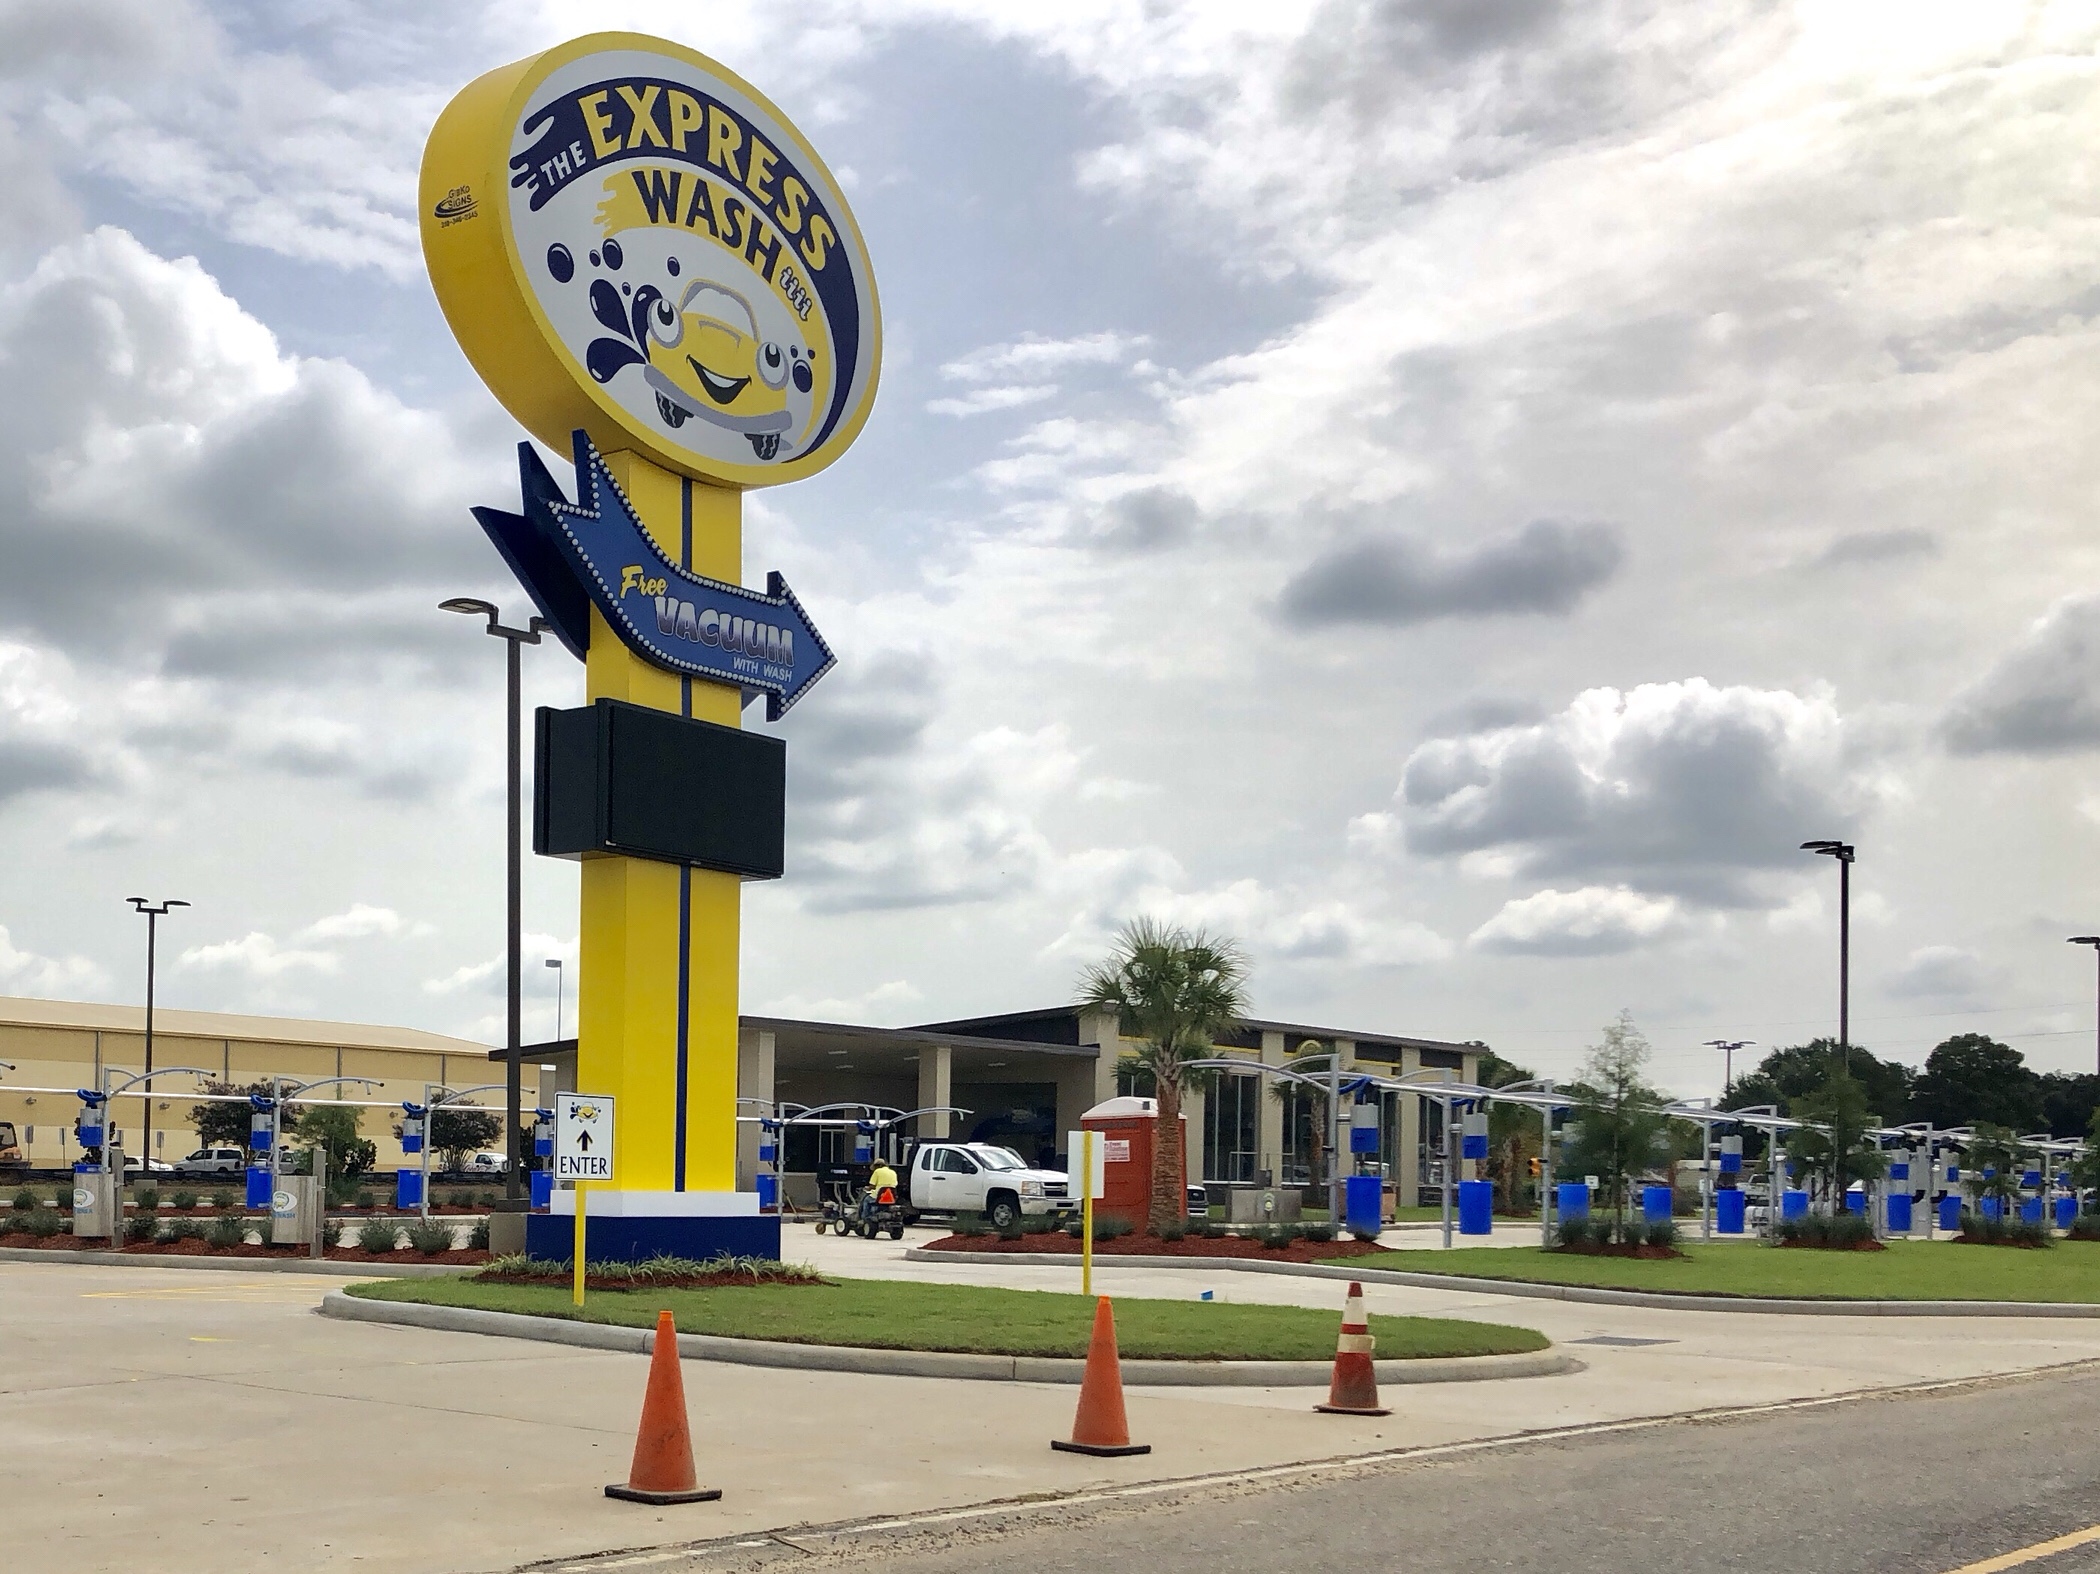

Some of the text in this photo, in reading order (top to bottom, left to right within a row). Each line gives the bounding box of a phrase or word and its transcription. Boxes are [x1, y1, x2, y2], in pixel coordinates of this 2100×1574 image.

[540, 85, 836, 271] THE EXPRESS
[447, 194, 472, 209] SIGNS
[631, 169, 782, 284] WASH
[619, 564, 669, 599] Free
[654, 596, 795, 667] VACUUM
[733, 656, 793, 683] WITH WASH
[560, 1155, 608, 1175] ENTER
